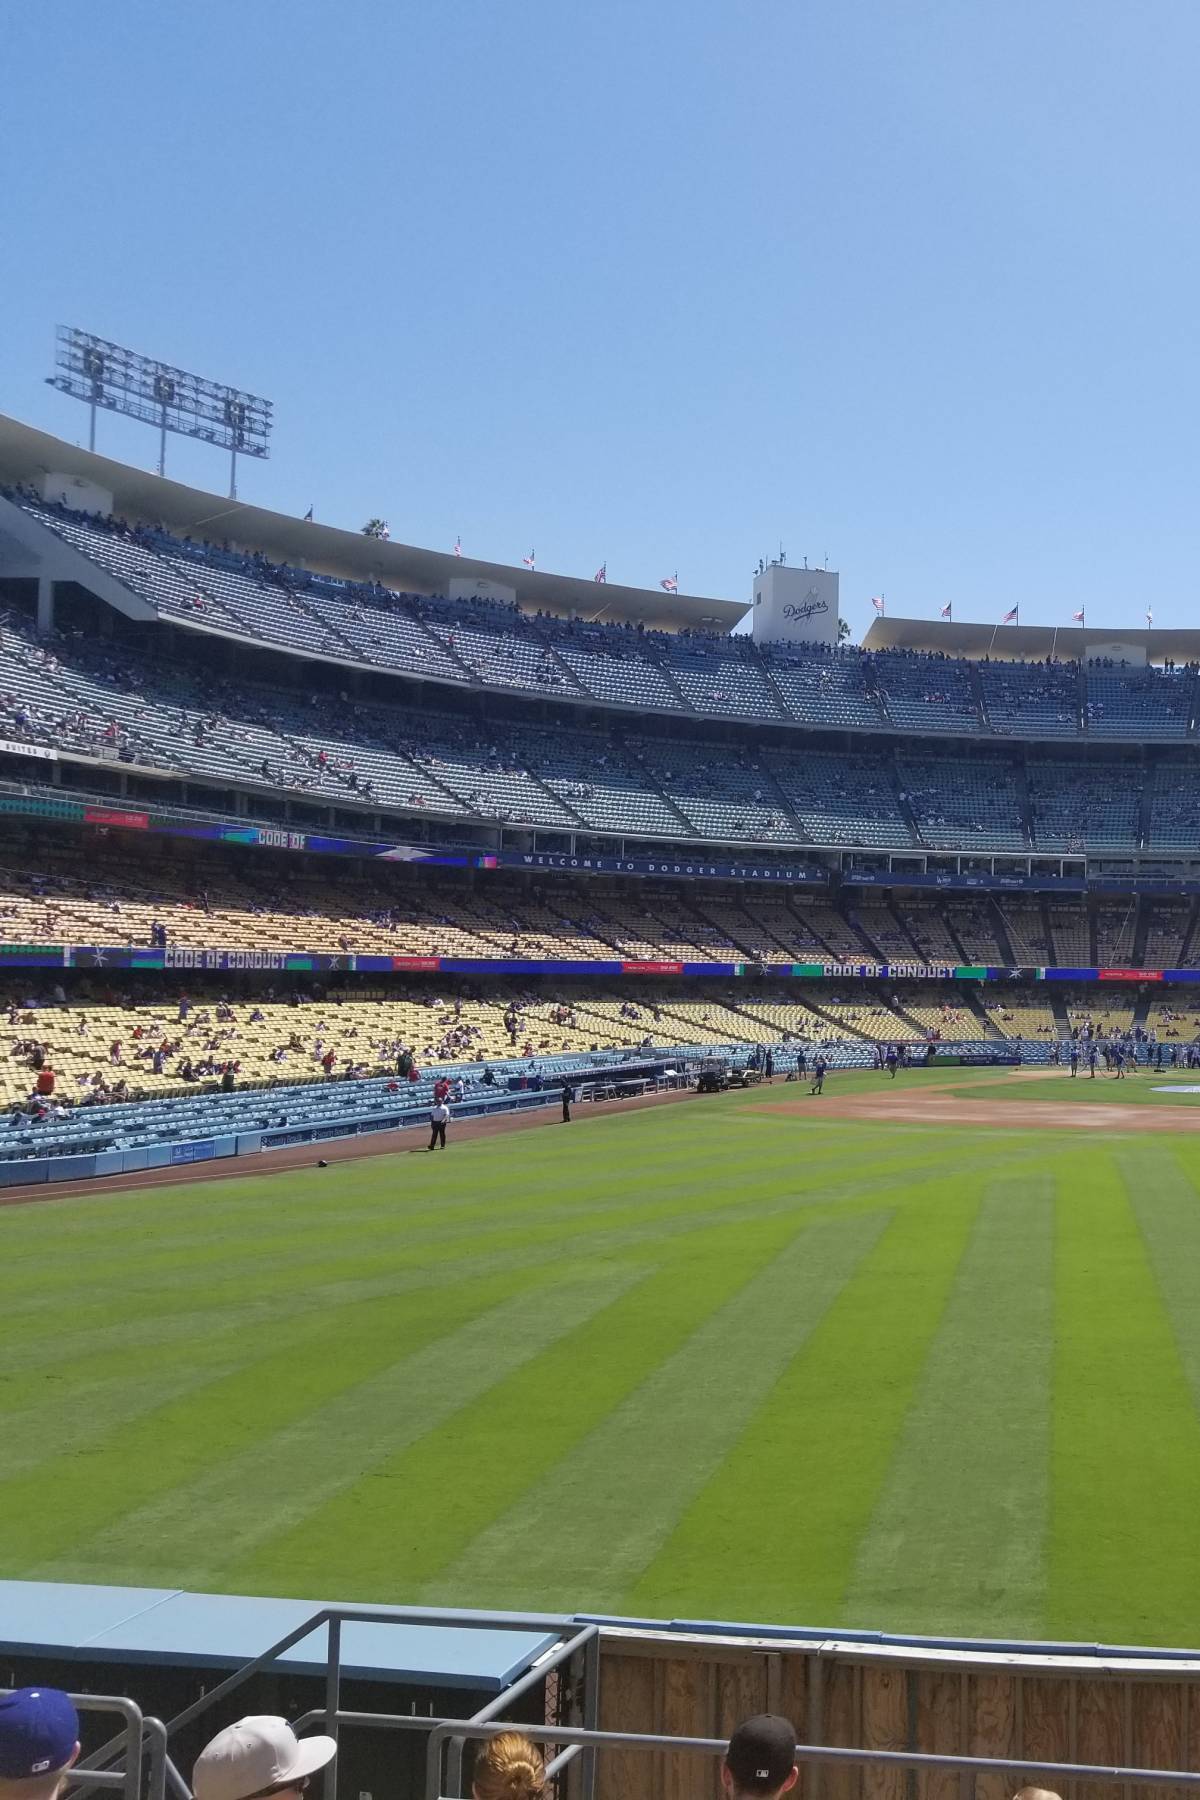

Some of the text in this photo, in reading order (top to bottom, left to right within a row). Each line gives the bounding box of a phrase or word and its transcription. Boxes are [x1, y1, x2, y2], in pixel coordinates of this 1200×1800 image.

[783, 600, 829, 621] Dodgers
[258, 830, 288, 848] CODE
[524, 855, 806, 879] WELCOME TO DODGER STADIUM
[164, 950, 287, 970] CODE OF CONDUCT
[823, 965, 955, 978] CODE OF CONDUCT
